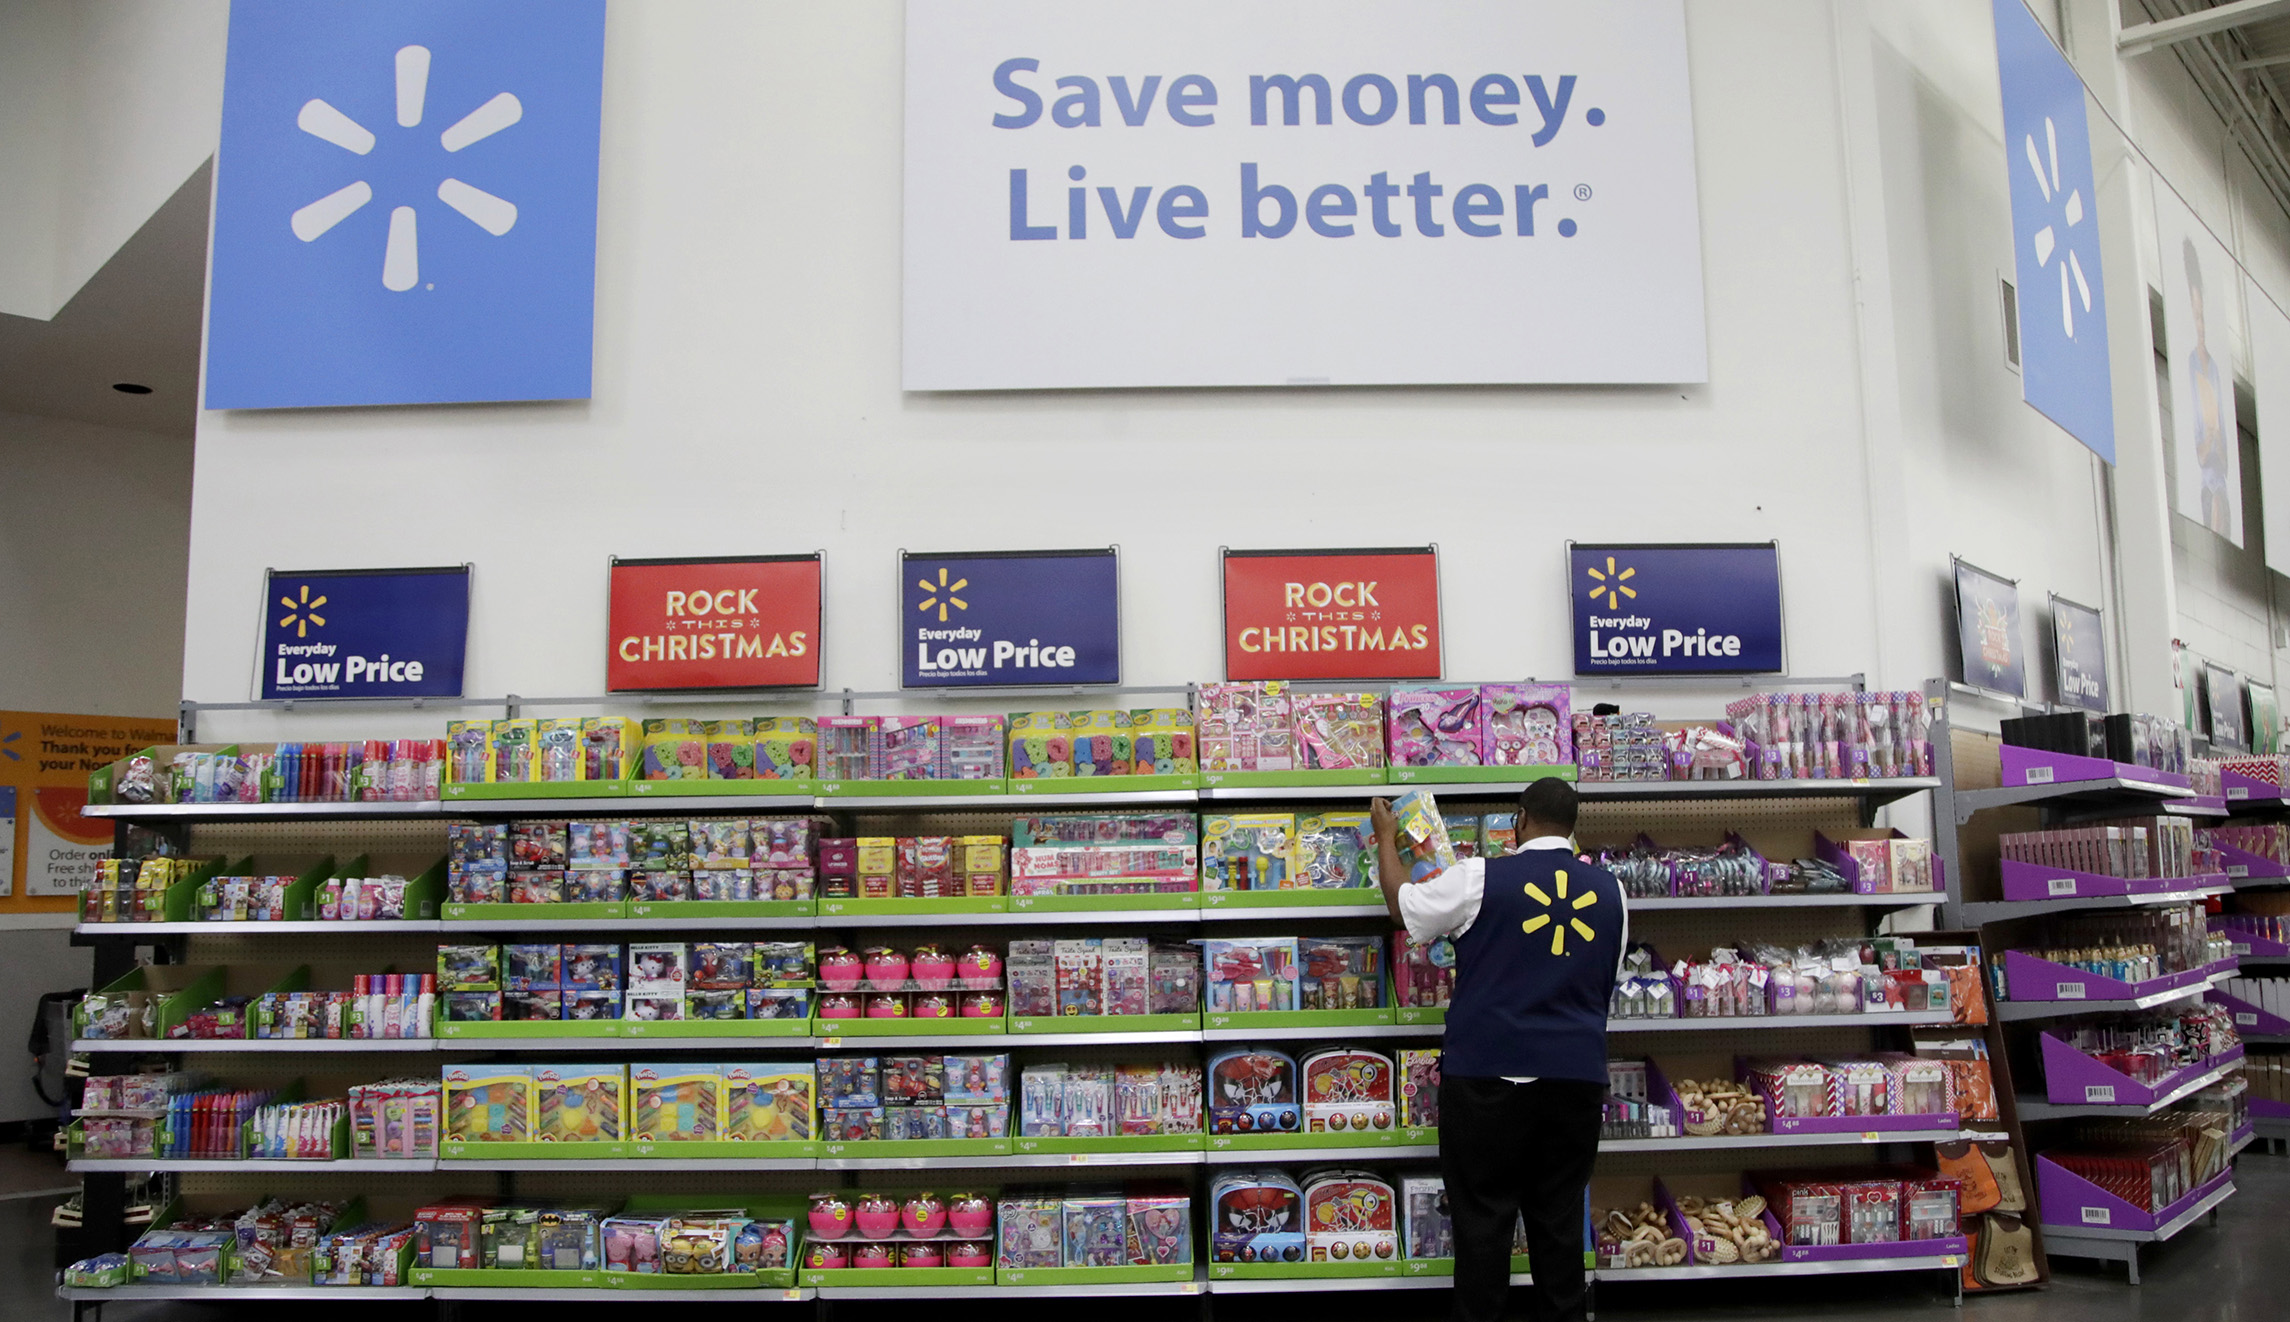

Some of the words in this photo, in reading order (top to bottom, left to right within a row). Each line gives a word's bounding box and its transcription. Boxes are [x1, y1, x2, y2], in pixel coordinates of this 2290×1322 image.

[992, 57, 1218, 130] Save
[1248, 72, 1606, 148] money.
[1009, 164, 1210, 241] Live
[1285, 581, 1380, 608] ROCK
[666, 588, 759, 616] ROCK
[1302, 611, 1365, 621] THIS
[681, 619, 744, 630] THIS
[1589, 615, 1650, 631] Everyday
[918, 626, 982, 643] Everyday
[1238, 623, 1429, 653] CHRISTMAS
[618, 631, 807, 662] CHRISTMAS
[1590, 630, 1657, 658] Low
[1662, 627, 1742, 657] Price
[278, 642, 337, 658] Everyday
[918, 642, 987, 670] Low
[993, 638, 1076, 668] Price
[1608, 658, 1621, 666] bajo
[276, 657, 341, 685] Low
[345, 653, 424, 683] Price
[936, 670, 950, 679] bajo
[2063, 669, 2081, 693] Low
[2081, 672, 2100, 698] Price
[1203, 687, 1220, 699] POP
[41, 724, 107, 739] Welcome
[111, 729, 125, 740] to
[41, 740, 89, 753] Thank
[91, 744, 121, 757] you
[1586, 755, 1595, 765] $1
[1677, 754, 1686, 763] $1
[1767, 751, 1777, 761] $3
[1854, 751, 1864, 761] $3
[40, 760, 75, 772] your
[183, 778, 192, 788] $1
[272, 778, 281, 787] $1
[360, 777, 370, 786] $3
[49, 848, 86, 860] Order
[47, 862, 75, 874] Free
[1775, 868, 1786, 878] $3
[1684, 872, 1694, 882] $1
[53, 878, 67, 888] to
[1862, 882, 1872, 891] $3
[204, 895, 213, 904] $1
[322, 894, 331, 903] $1
[1689, 988, 1698, 998] $1
[1781, 987, 1791, 997] $3
[1872, 992, 1883, 1002] $3
[220, 1013, 230, 1023] $1
[260, 1012, 270, 1021] $1
[352, 1012, 361, 1021] $3
[1405, 1050, 1437, 1066] Barbie
[1690, 1112, 1700, 1122] $1
[162, 1133, 171, 1142] $1
[253, 1133, 262, 1142] $1
[357, 1132, 367, 1142] $3
[1606, 1245, 1616, 1255] $1
[1701, 1241, 1711, 1251] $1
[231, 1258, 241, 1268] $1
[318, 1257, 327, 1267] $1
[136, 1265, 145, 1275] $1
